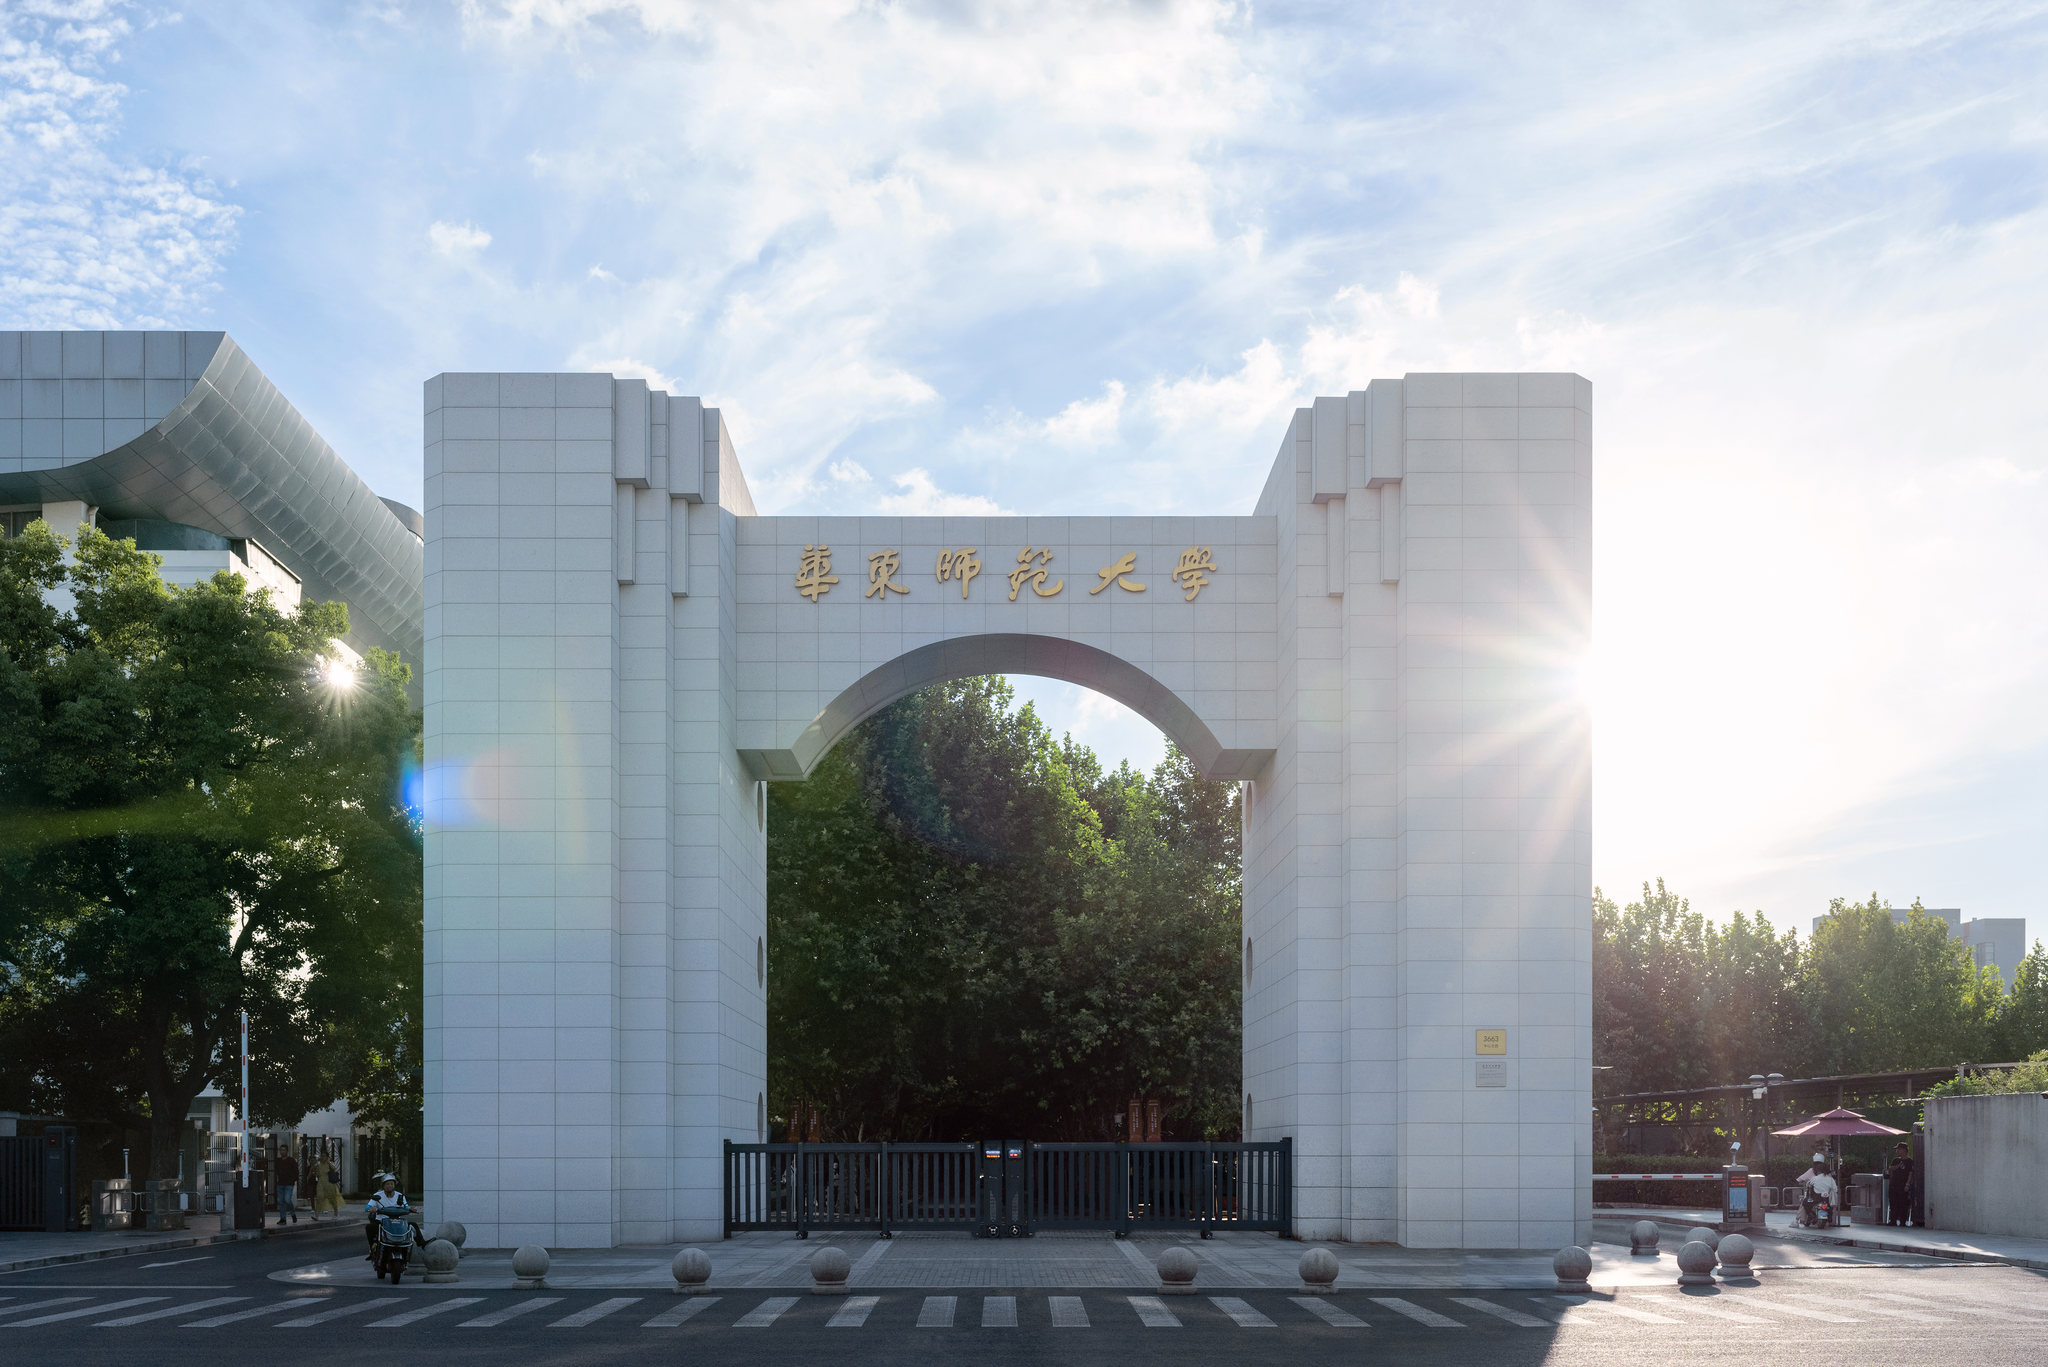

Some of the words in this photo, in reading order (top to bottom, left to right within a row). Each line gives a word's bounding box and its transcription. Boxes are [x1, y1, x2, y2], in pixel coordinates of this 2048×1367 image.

[795, 544, 1217, 602] 華東師範大學
